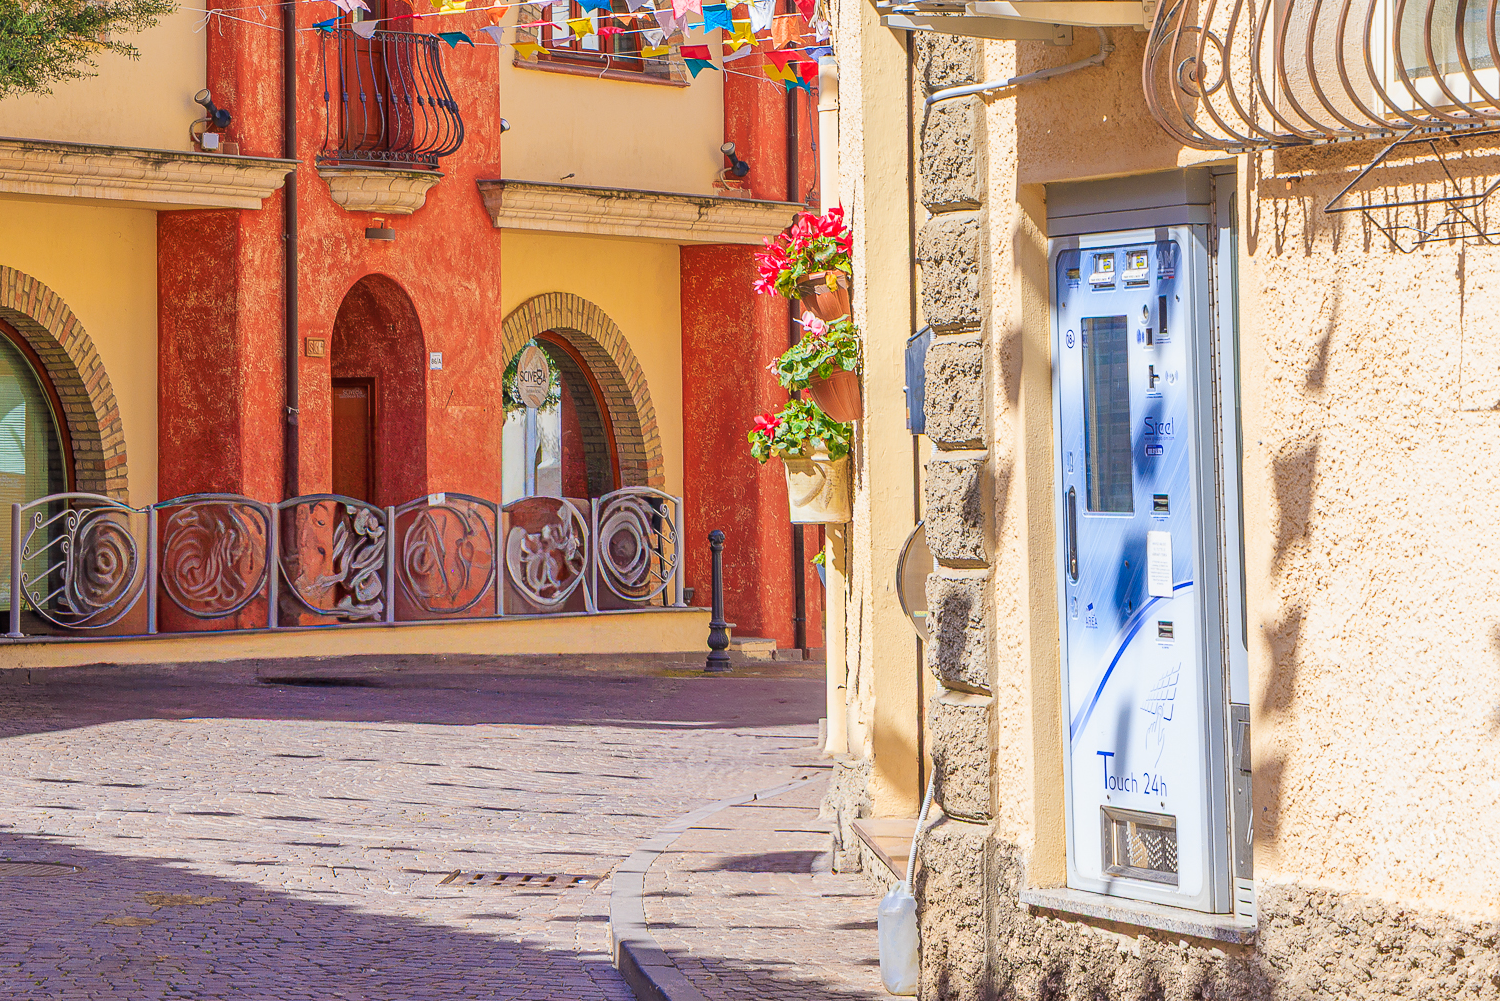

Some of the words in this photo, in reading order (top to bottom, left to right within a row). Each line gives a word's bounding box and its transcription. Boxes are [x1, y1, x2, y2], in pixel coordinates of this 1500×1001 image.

[1144, 417, 1175, 436] Steel
[1096, 750, 1138, 794] Touch
[1143, 772, 1168, 797] 24h
